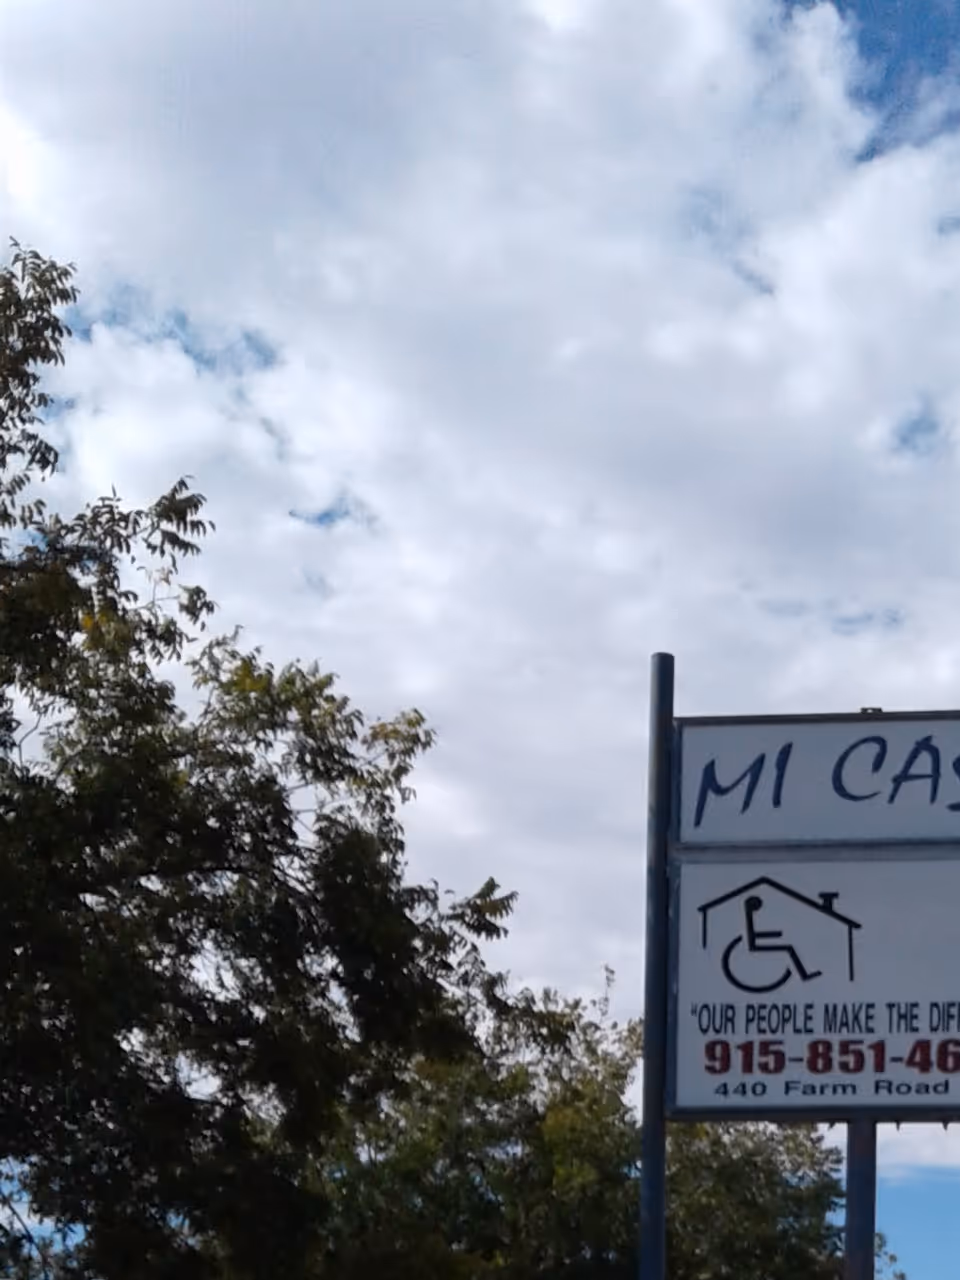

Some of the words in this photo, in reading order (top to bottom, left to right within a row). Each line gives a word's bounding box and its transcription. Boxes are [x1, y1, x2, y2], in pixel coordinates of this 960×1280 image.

[694, 742, 793, 828] MI
[691, 1003, 736, 1035] "OUR
[745, 1003, 814, 1035] PEOPLE
[823, 1003, 876, 1034] MAKE
[886, 1002, 920, 1034] THE
[714, 1082, 768, 1097] 440
[784, 1079, 858, 1096] Farm
[874, 1079, 950, 1096] Road
